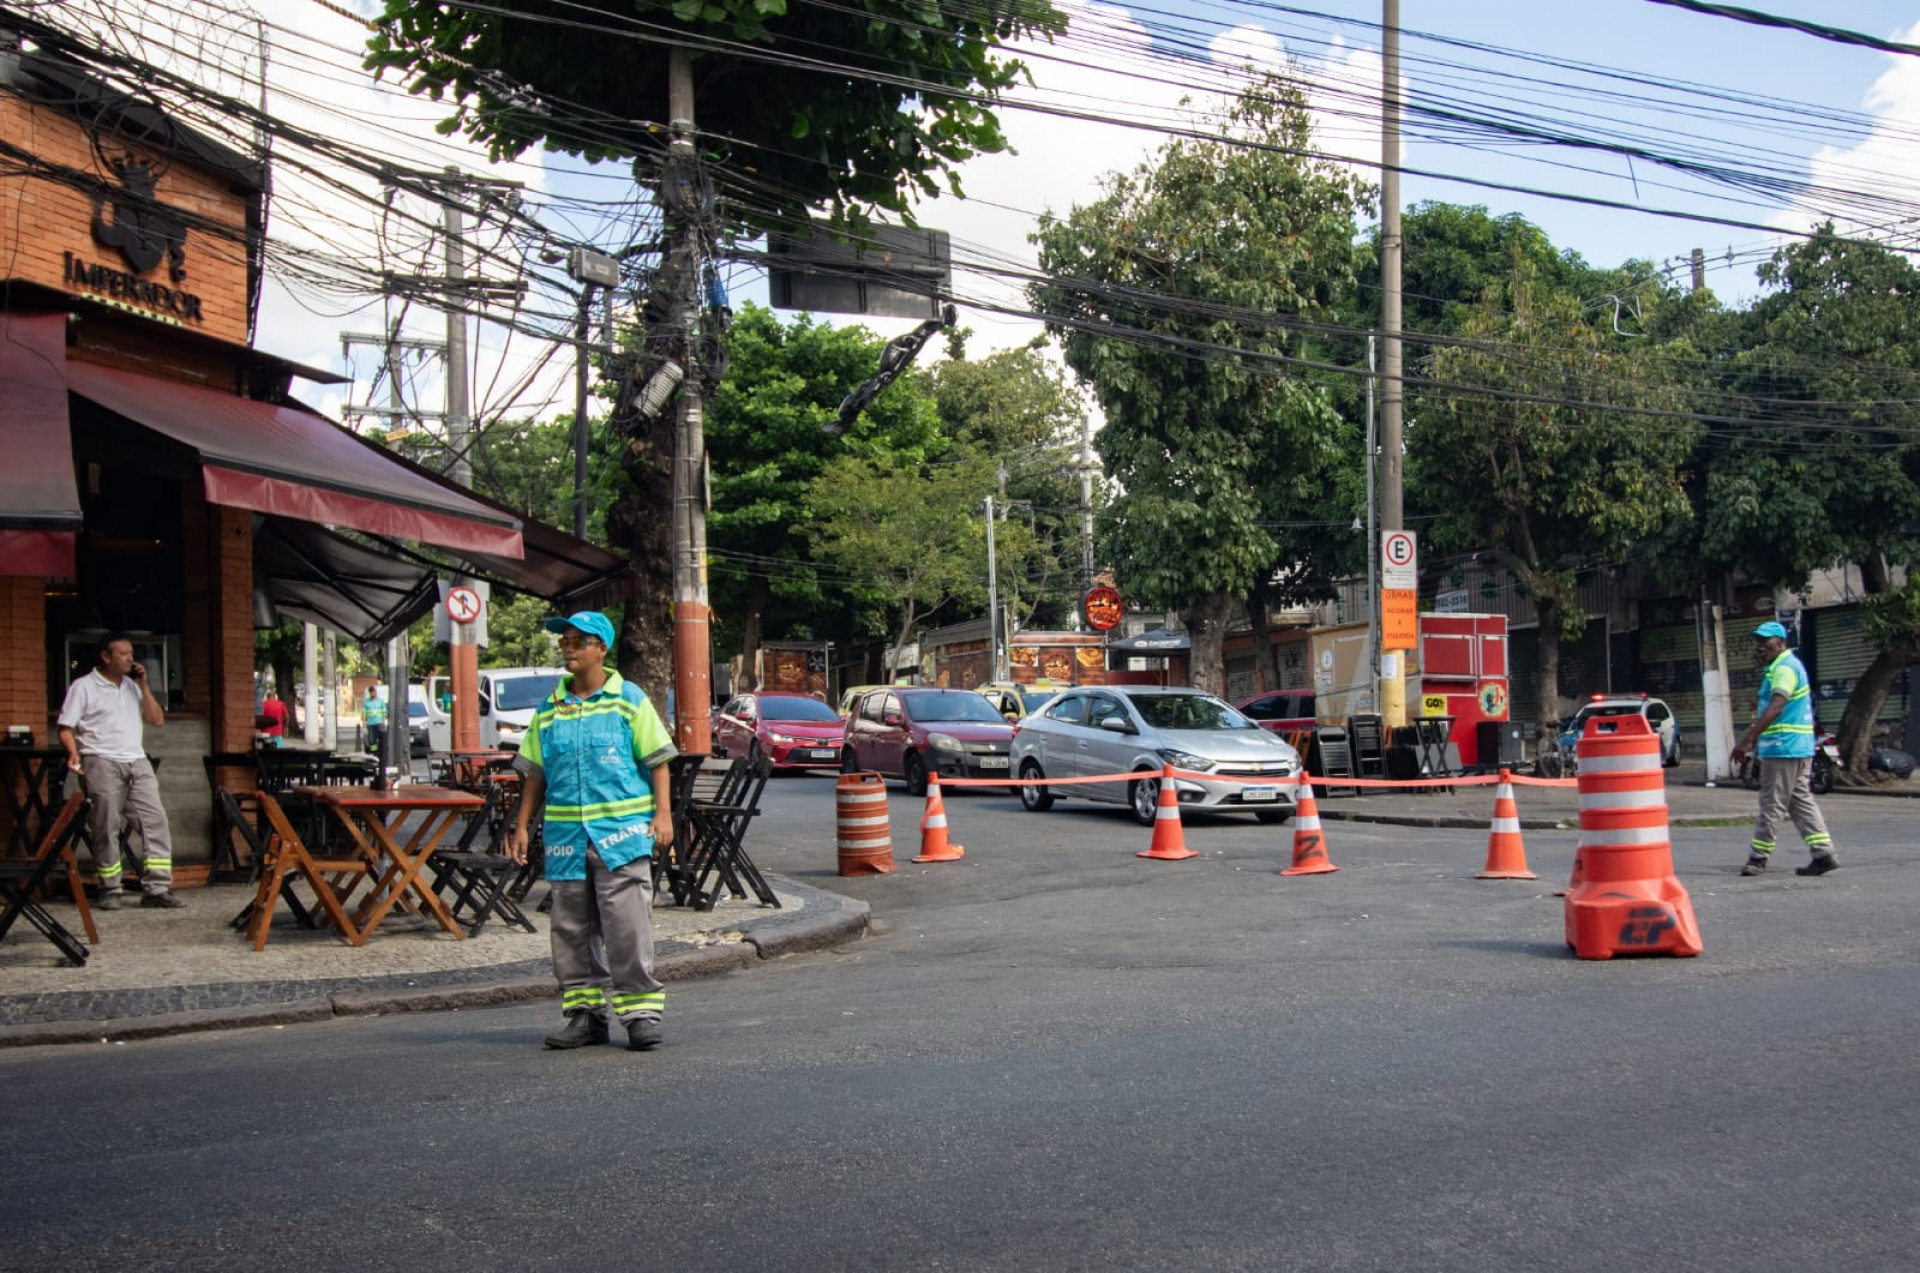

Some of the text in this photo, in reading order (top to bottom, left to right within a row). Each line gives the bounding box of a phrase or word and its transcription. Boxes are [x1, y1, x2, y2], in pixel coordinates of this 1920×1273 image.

[64, 251, 203, 321] IMPERADOR
[1394, 540, 1405, 560] E
[545, 844, 574, 857] POIO
